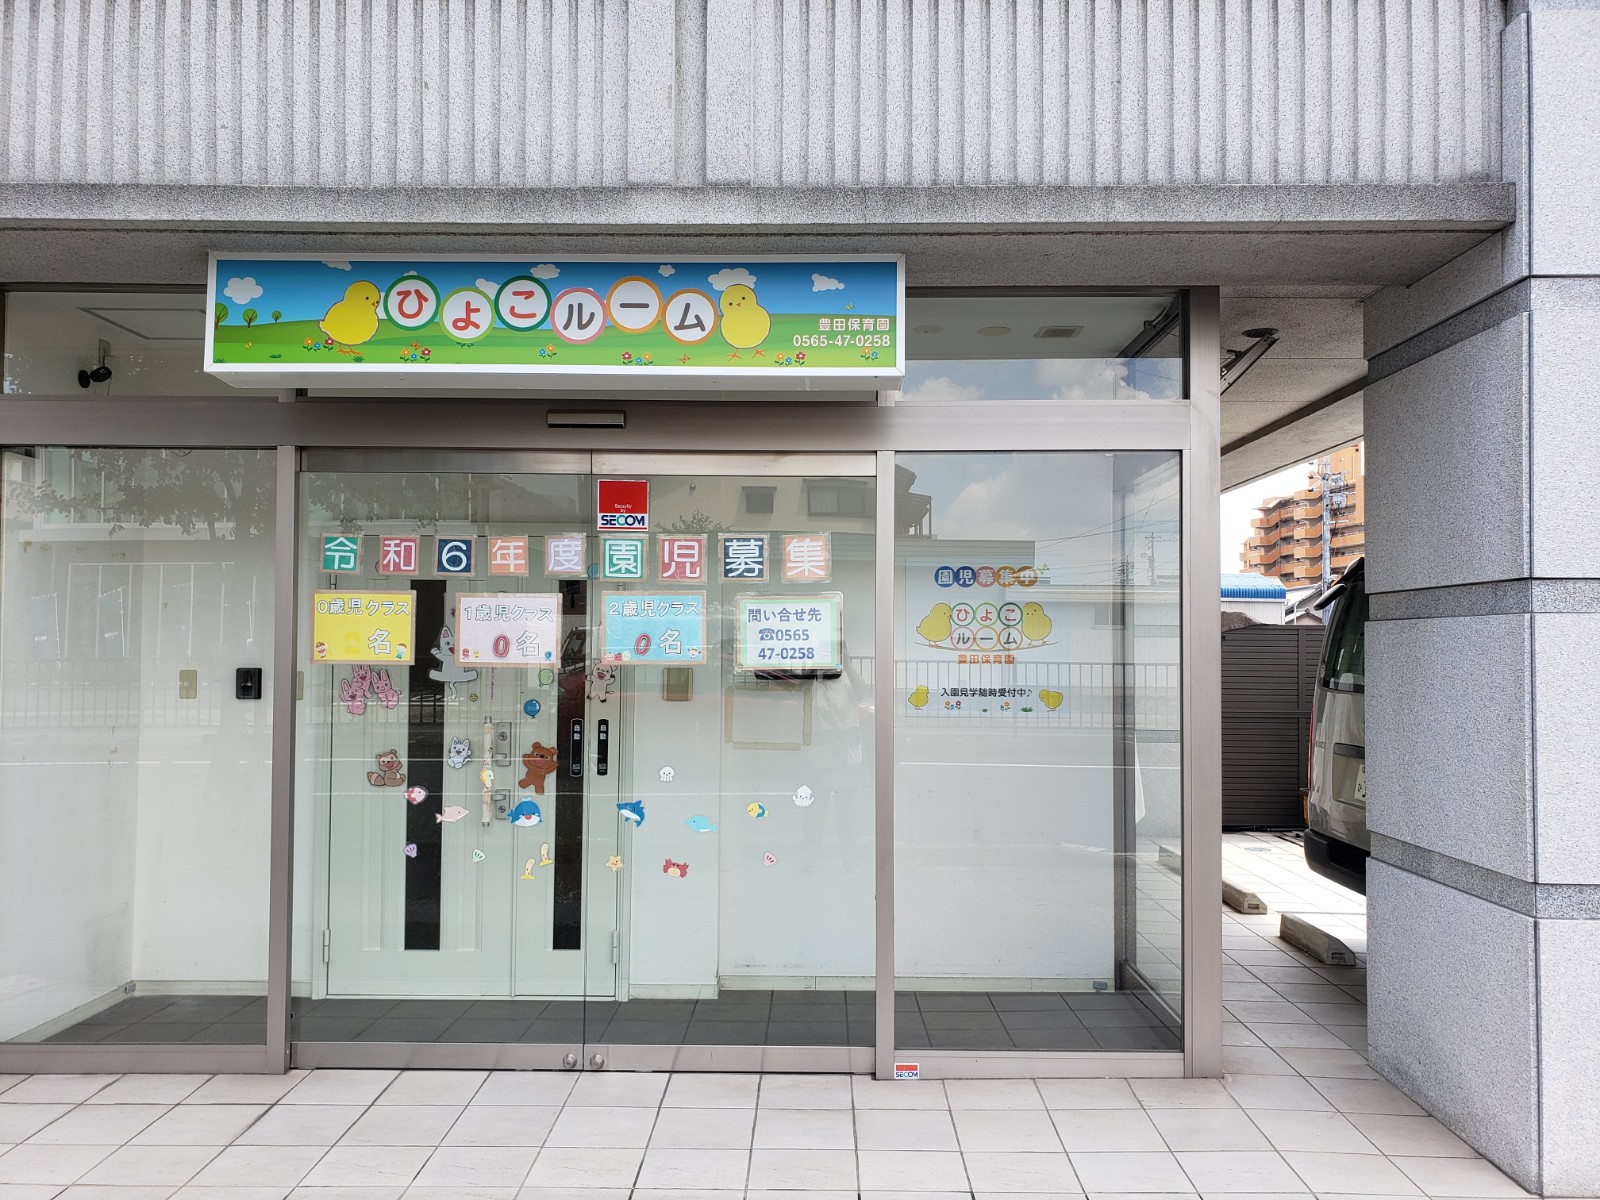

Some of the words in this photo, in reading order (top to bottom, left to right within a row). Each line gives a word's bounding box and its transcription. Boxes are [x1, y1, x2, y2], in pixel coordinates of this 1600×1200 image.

[396, 288, 706, 332] ひよこルーム
[818, 318, 890, 331] 豊田保育園
[793, 334, 891, 347] 0565-47-0258
[601, 514, 645, 526] SECOM
[324, 536, 826, 578] 令和6年度園児募集
[937, 569, 1036, 585] 園児募集中
[317, 598, 410, 616] 0歳児クラス
[464, 604, 554, 622] 1歳児クラス
[609, 600, 700, 617] 2歳児クラス
[748, 607, 822, 623] 問い合せ先
[956, 608, 1017, 622] ひよこ
[368, 628, 391, 655] 名
[775, 629, 809, 641] 0565
[956, 632, 1018, 645] ルーム
[758, 647, 815, 660] 47-0258
[957, 654, 1015, 664] 豊田保育園
